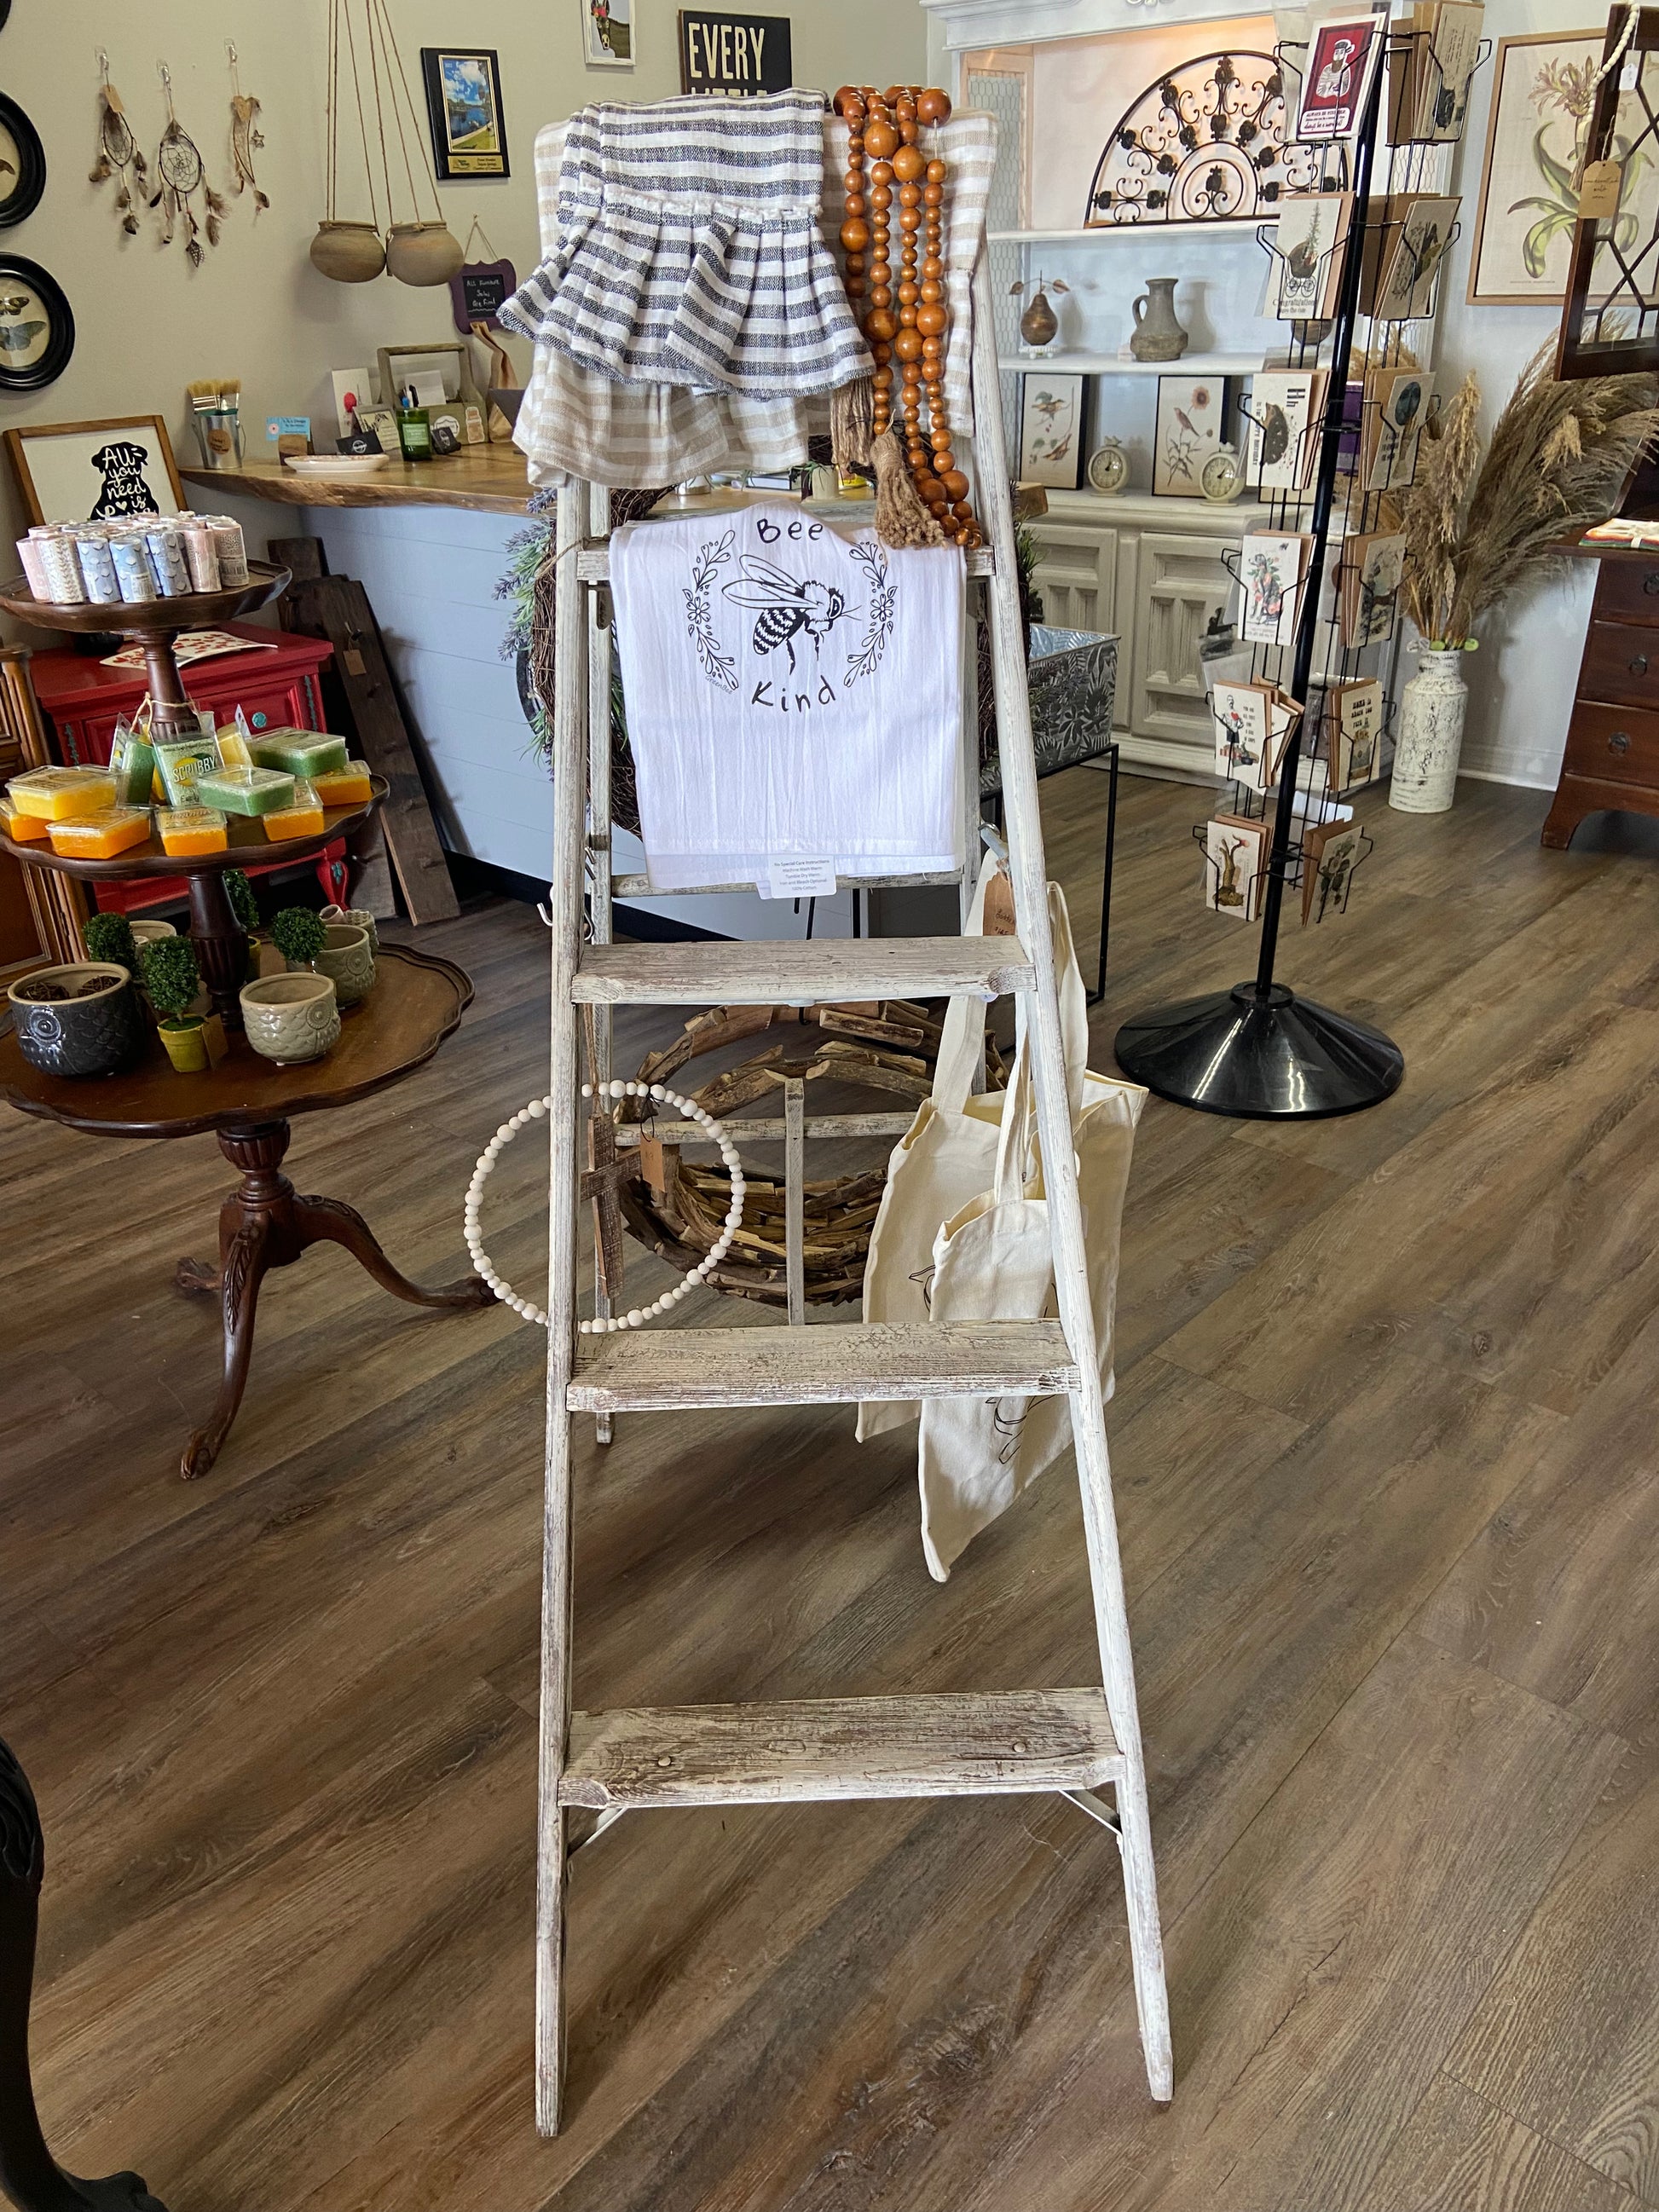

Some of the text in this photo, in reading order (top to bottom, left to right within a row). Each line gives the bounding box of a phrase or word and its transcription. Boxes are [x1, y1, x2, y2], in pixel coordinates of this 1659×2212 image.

[688, 22, 765, 81] EVERY
[102, 448, 136, 470] All
[107, 467, 141, 488] you
[107, 477, 147, 500] need
[130, 495, 147, 510] is
[756, 518, 824, 544] Bee
[751, 674, 836, 713] Kind
[172, 756, 217, 783] SCRUBBY
